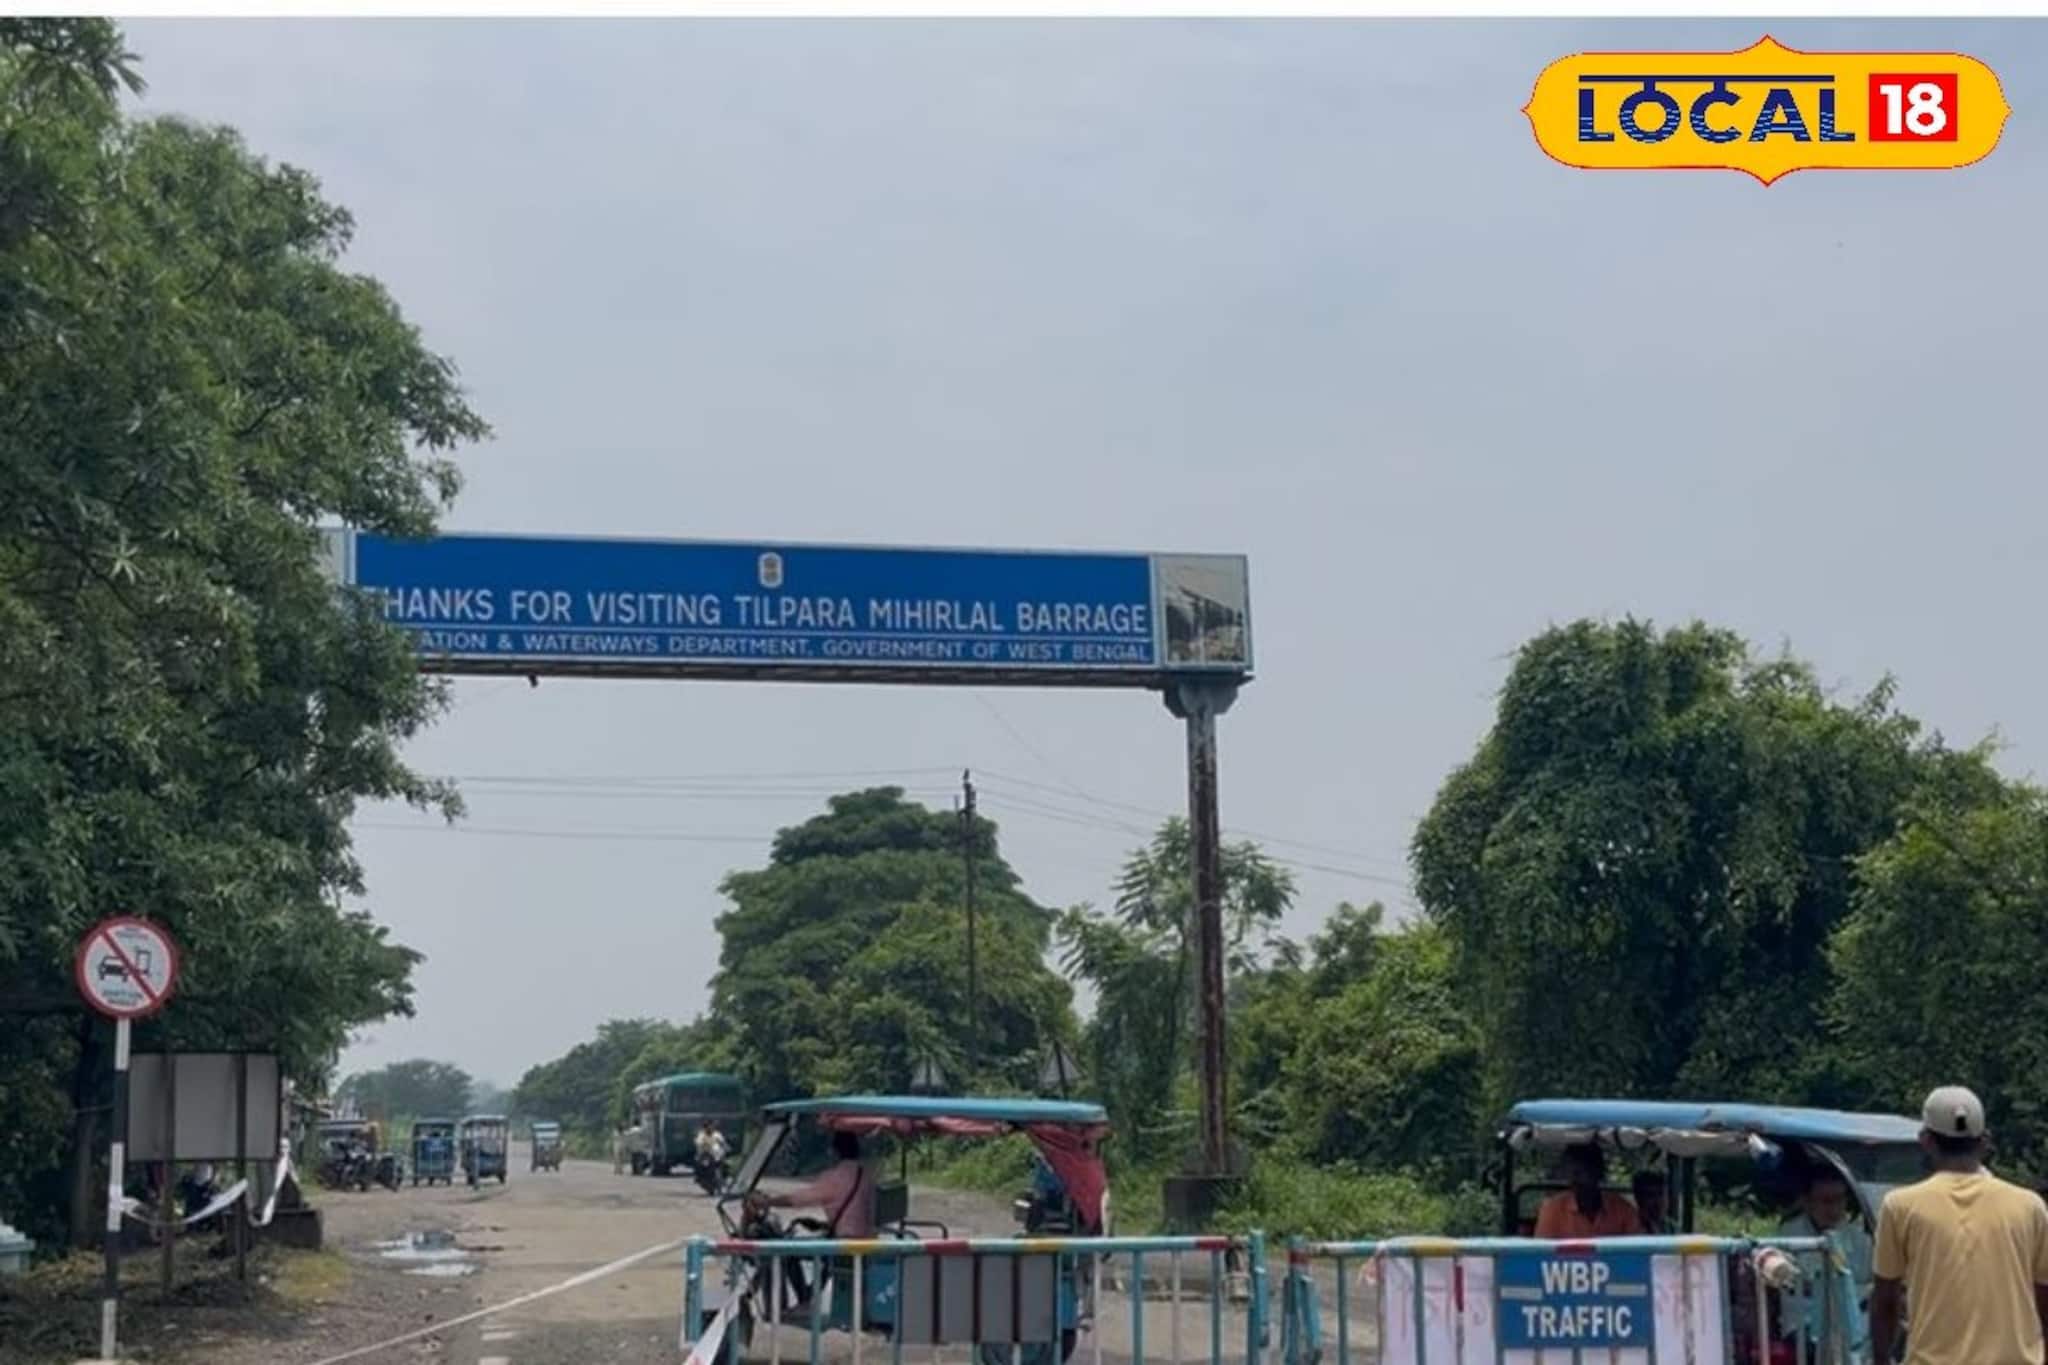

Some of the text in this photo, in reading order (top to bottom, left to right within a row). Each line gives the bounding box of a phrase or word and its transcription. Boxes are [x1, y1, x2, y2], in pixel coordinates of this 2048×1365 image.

[510, 590, 572, 621] FOR
[587, 591, 722, 625] VISITING
[734, 595, 856, 627] TILPARA
[869, 598, 1004, 631] MIHIRLAL
[1016, 602, 1148, 633] BARRAGE
[497, 632, 513, 650] &
[522, 633, 659, 652] WATERWAYS
[823, 638, 964, 658] GOVERNMENT
[972, 641, 999, 658] OF
[1007, 642, 1063, 660] WEST
[1072, 644, 1149, 661] BENGAL
[1540, 1260, 1610, 1295] WBP
[1522, 1305, 1633, 1338] TRAFFIC
